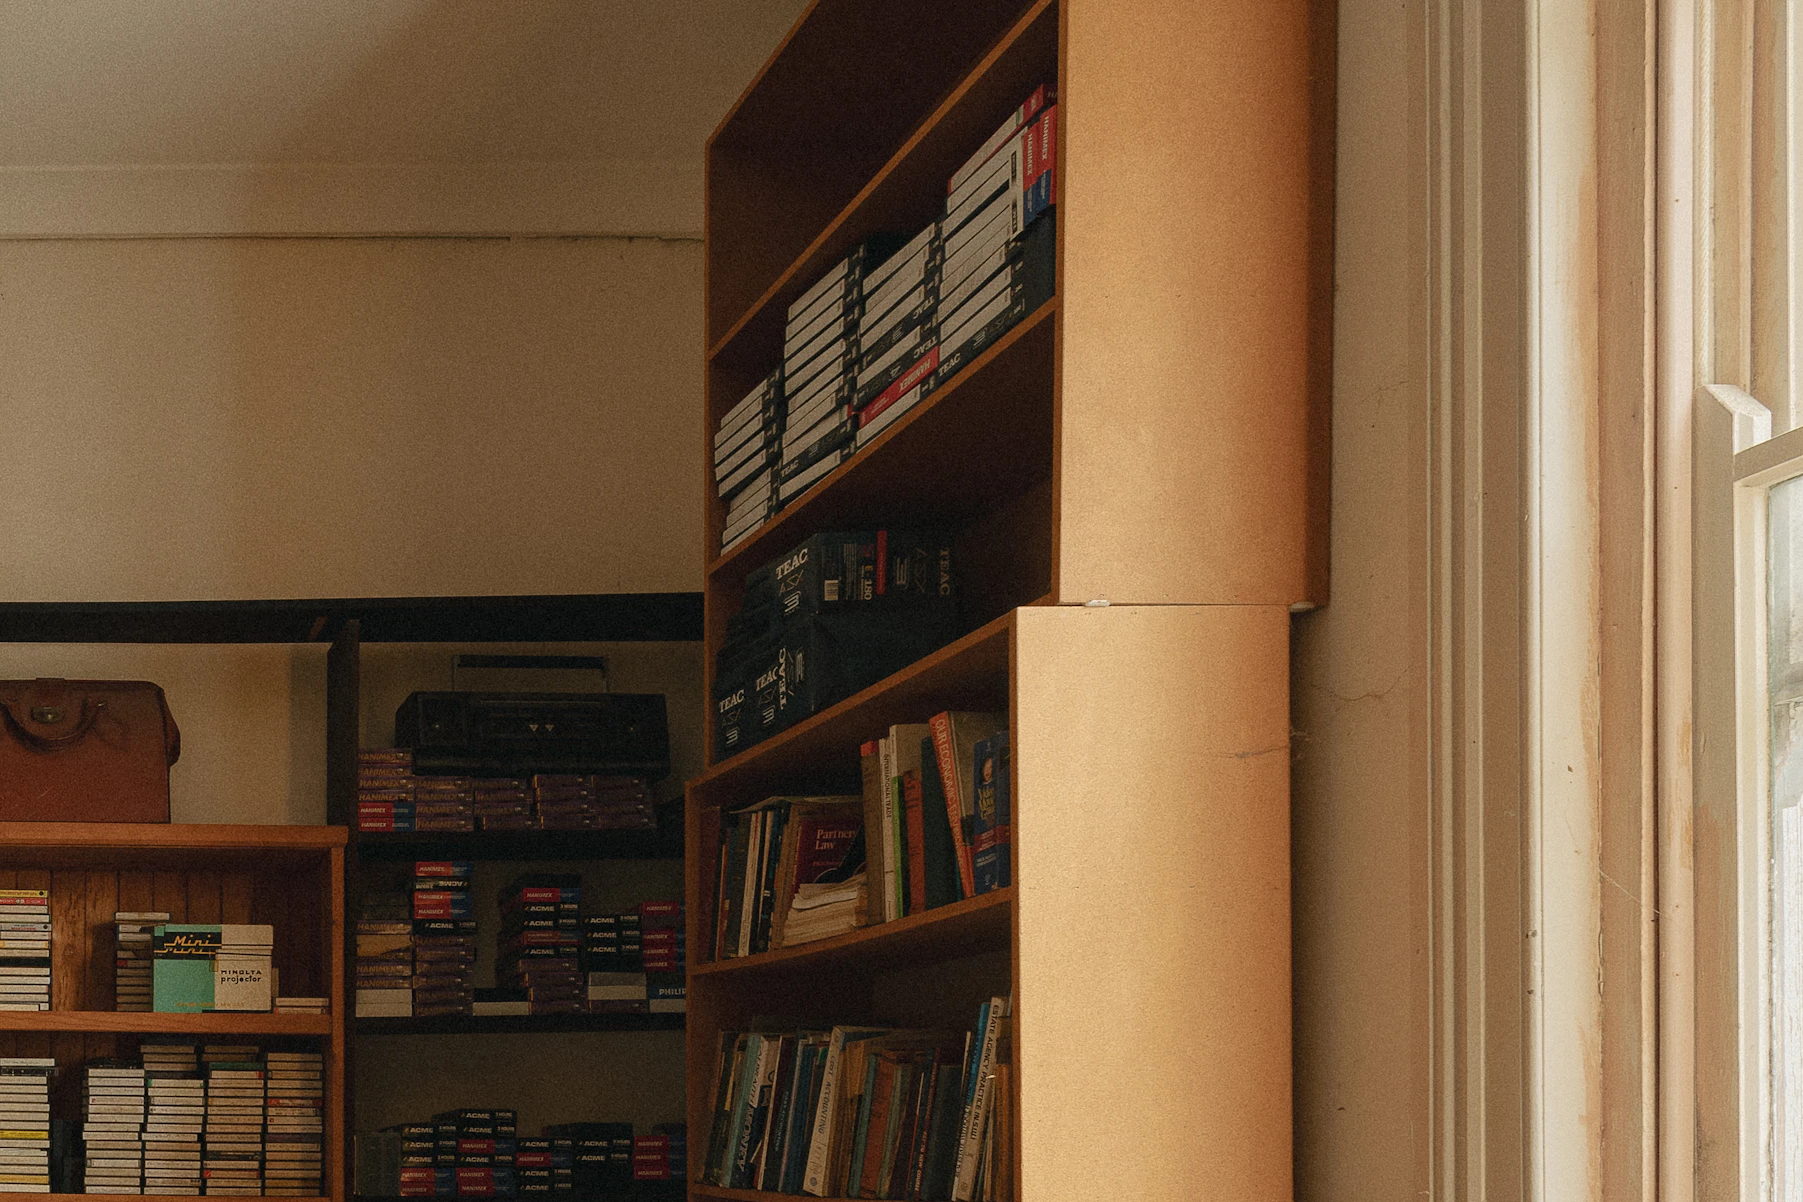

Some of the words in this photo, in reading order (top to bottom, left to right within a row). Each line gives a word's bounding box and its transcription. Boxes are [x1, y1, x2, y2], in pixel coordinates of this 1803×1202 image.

[1041, 114, 1051, 161] HANIMEX
[937, 352, 962, 378] TEAC
[775, 547, 810, 581] TEAC
[939, 549, 951, 596] TEAC
[755, 665, 780, 693] TEAC
[718, 689, 746, 714] TEAC
[935, 718, 949, 747] OUR
[938, 746, 959, 804] ECONOMIC
[814, 839, 837, 851] Law
[815, 828, 856, 841] Partner
[220, 975, 263, 985] projector
[988, 1003, 1000, 1034] ESTATE
[982, 1035, 994, 1070] AGENCY
[974, 1069, 988, 1112] PRACTICE
[465, 1112, 490, 1120] ACME
[818, 1080, 833, 1135] ACCOUNTING
[409, 1141, 434, 1149] ACME
[736, 1104, 756, 1173] MONEY
[408, 1156, 433, 1164] ACME
